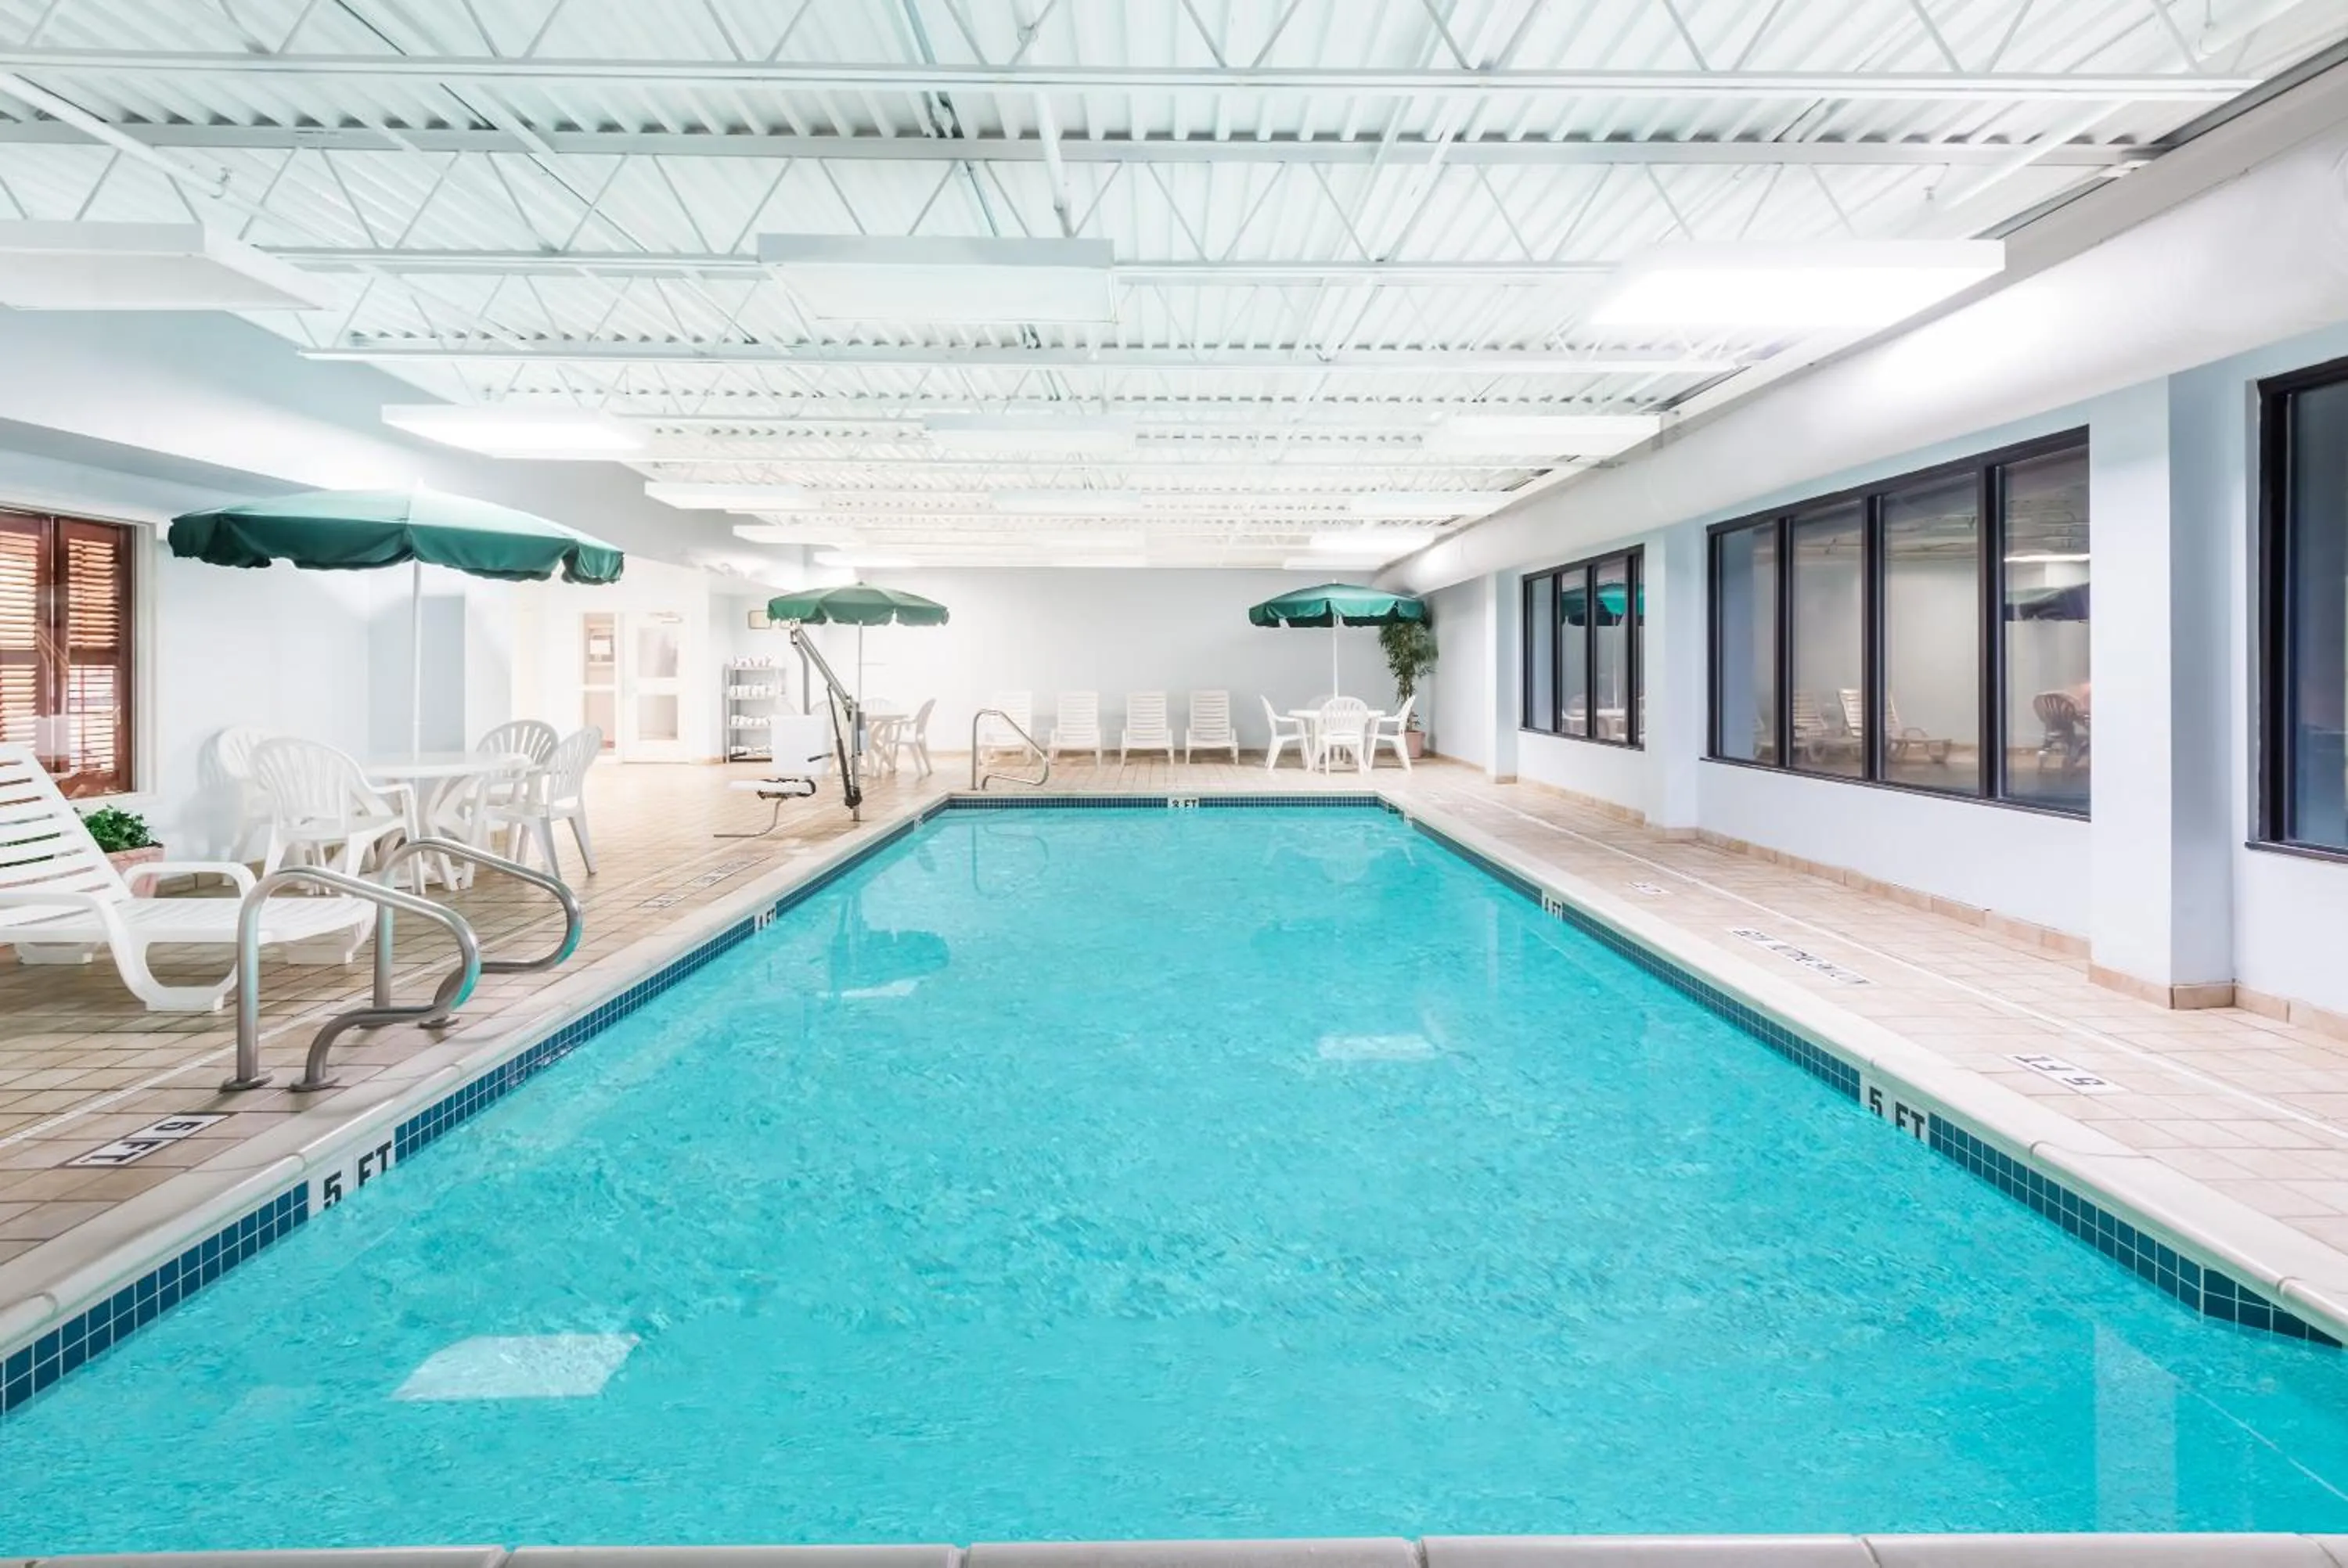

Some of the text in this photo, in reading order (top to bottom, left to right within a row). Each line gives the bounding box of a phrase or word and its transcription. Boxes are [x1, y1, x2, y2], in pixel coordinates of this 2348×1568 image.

[1183, 799, 1197, 808] FT
[2062, 1077, 2107, 1086] 5
[1869, 1085, 1925, 1140] 5 FT
[90, 1121, 204, 1163] 5 FT
[323, 1140, 392, 1210] 5 FT
